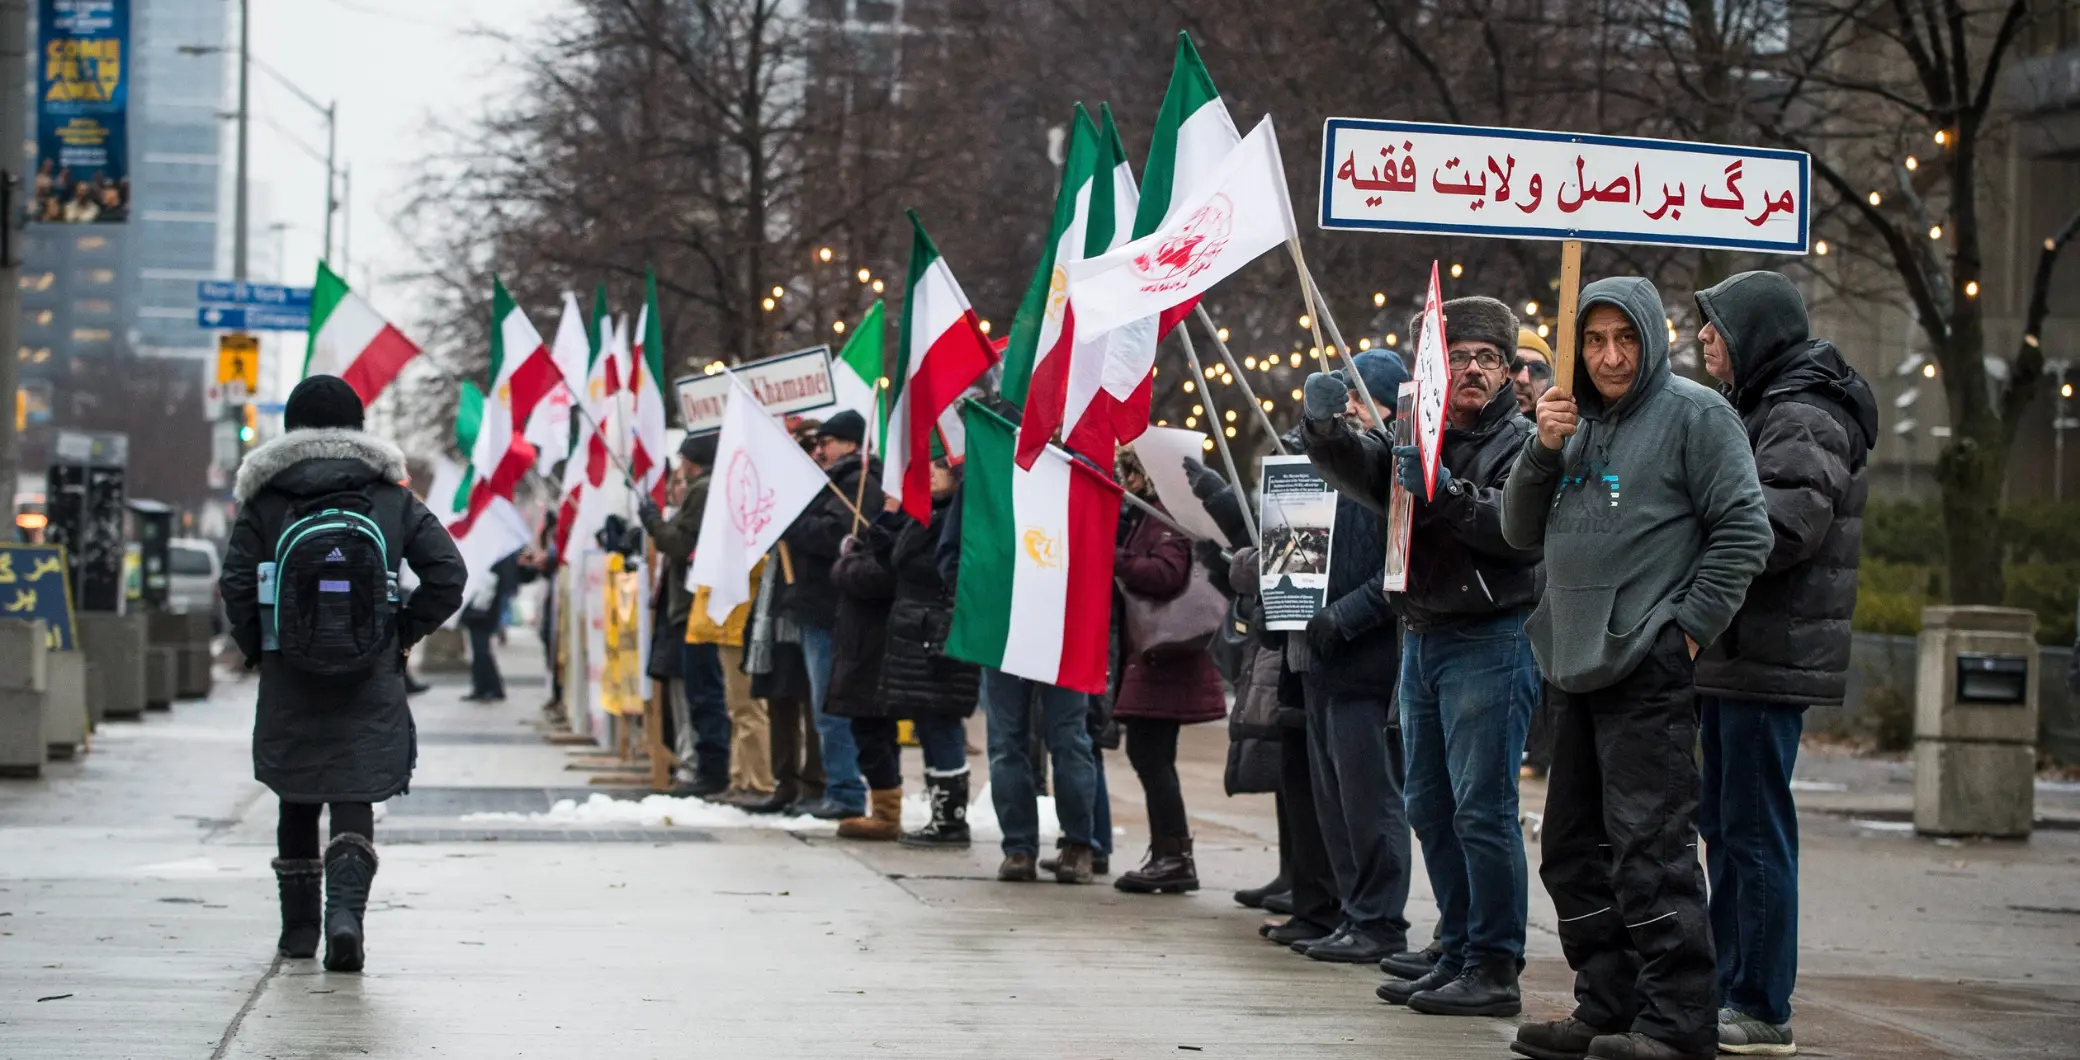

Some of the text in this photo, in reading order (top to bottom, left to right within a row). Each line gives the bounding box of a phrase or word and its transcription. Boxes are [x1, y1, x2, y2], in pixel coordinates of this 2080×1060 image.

[47, 39, 120, 58] COME
[45, 80, 117, 102] AWAY
[1337, 140, 1417, 208] فقیه
[1432, 153, 1543, 213] ولایت
[1700, 159, 1794, 226] مرگ
